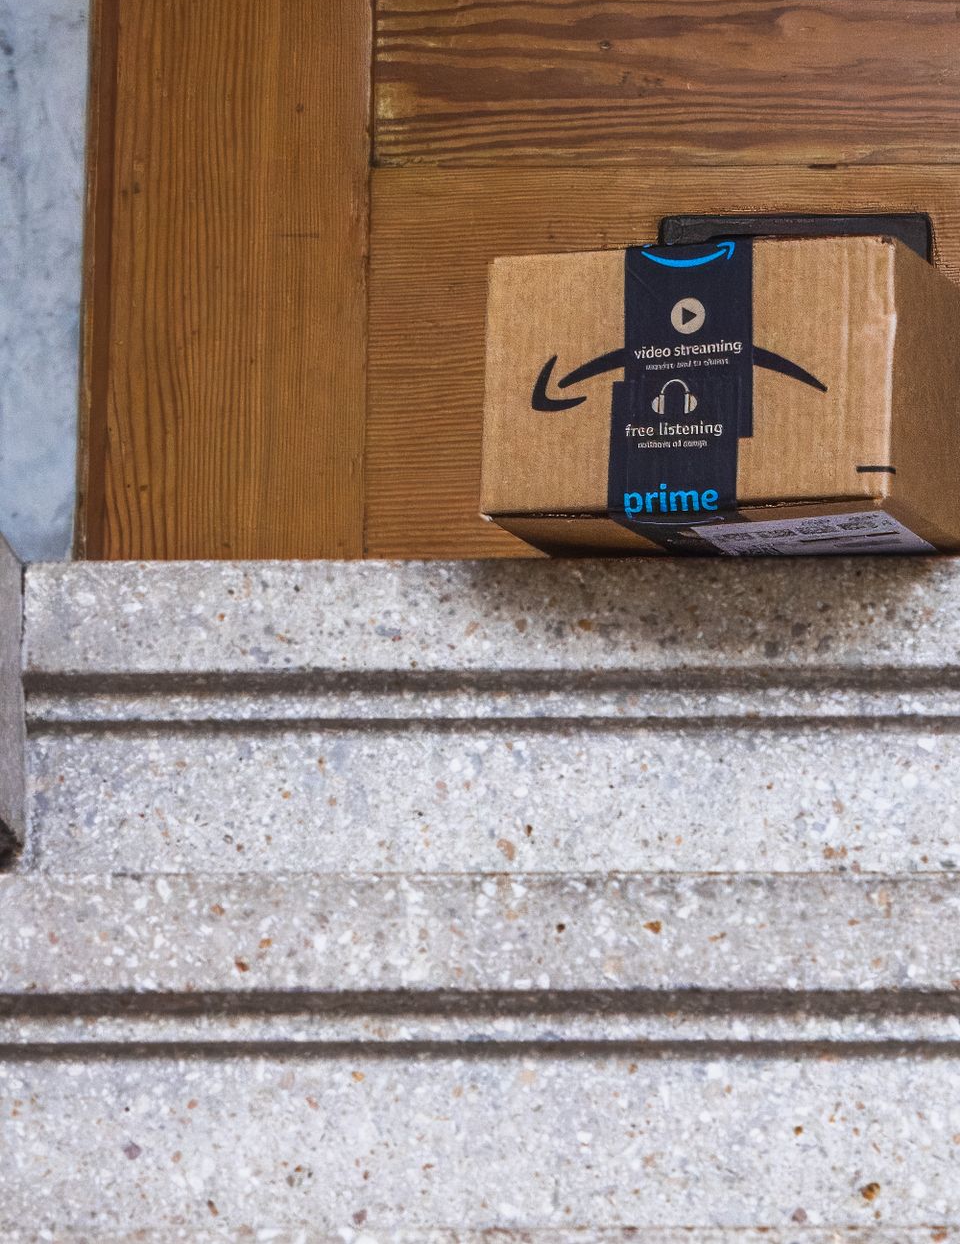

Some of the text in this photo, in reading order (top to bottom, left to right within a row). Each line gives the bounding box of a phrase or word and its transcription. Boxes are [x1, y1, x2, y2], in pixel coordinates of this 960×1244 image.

[634, 340, 743, 360] video streaming
[625, 420, 723, 437] free listening
[624, 483, 718, 519] prime
